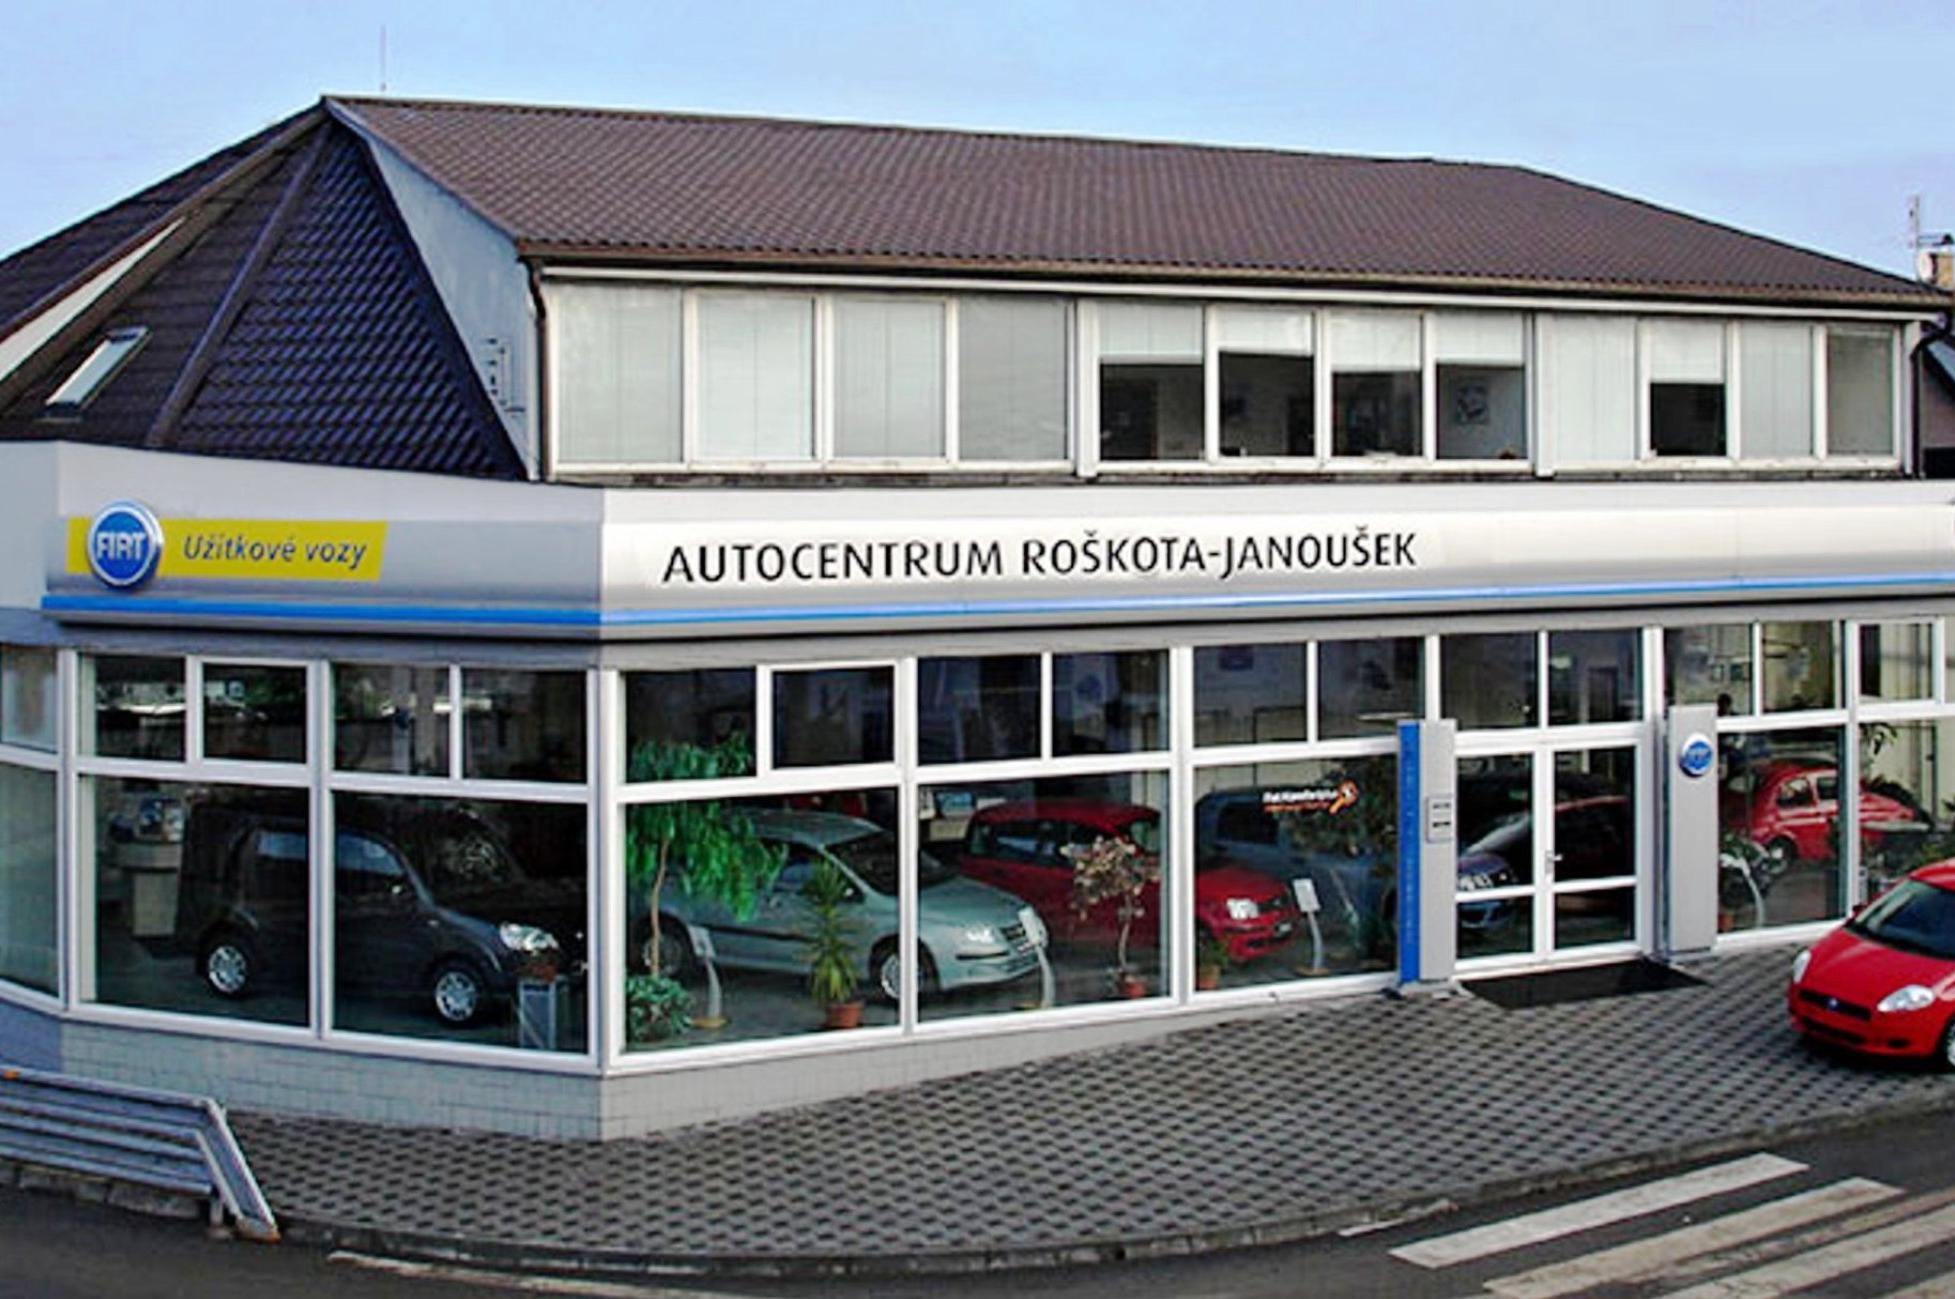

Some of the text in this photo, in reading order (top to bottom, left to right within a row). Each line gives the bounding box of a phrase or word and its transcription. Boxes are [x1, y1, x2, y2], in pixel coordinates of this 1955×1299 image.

[97, 531, 146, 560] FIAT
[306, 541, 367, 571] vozy
[663, 526, 1417, 582] AUTOCENTRUM ROŠKOTA-JANOUŠEK
